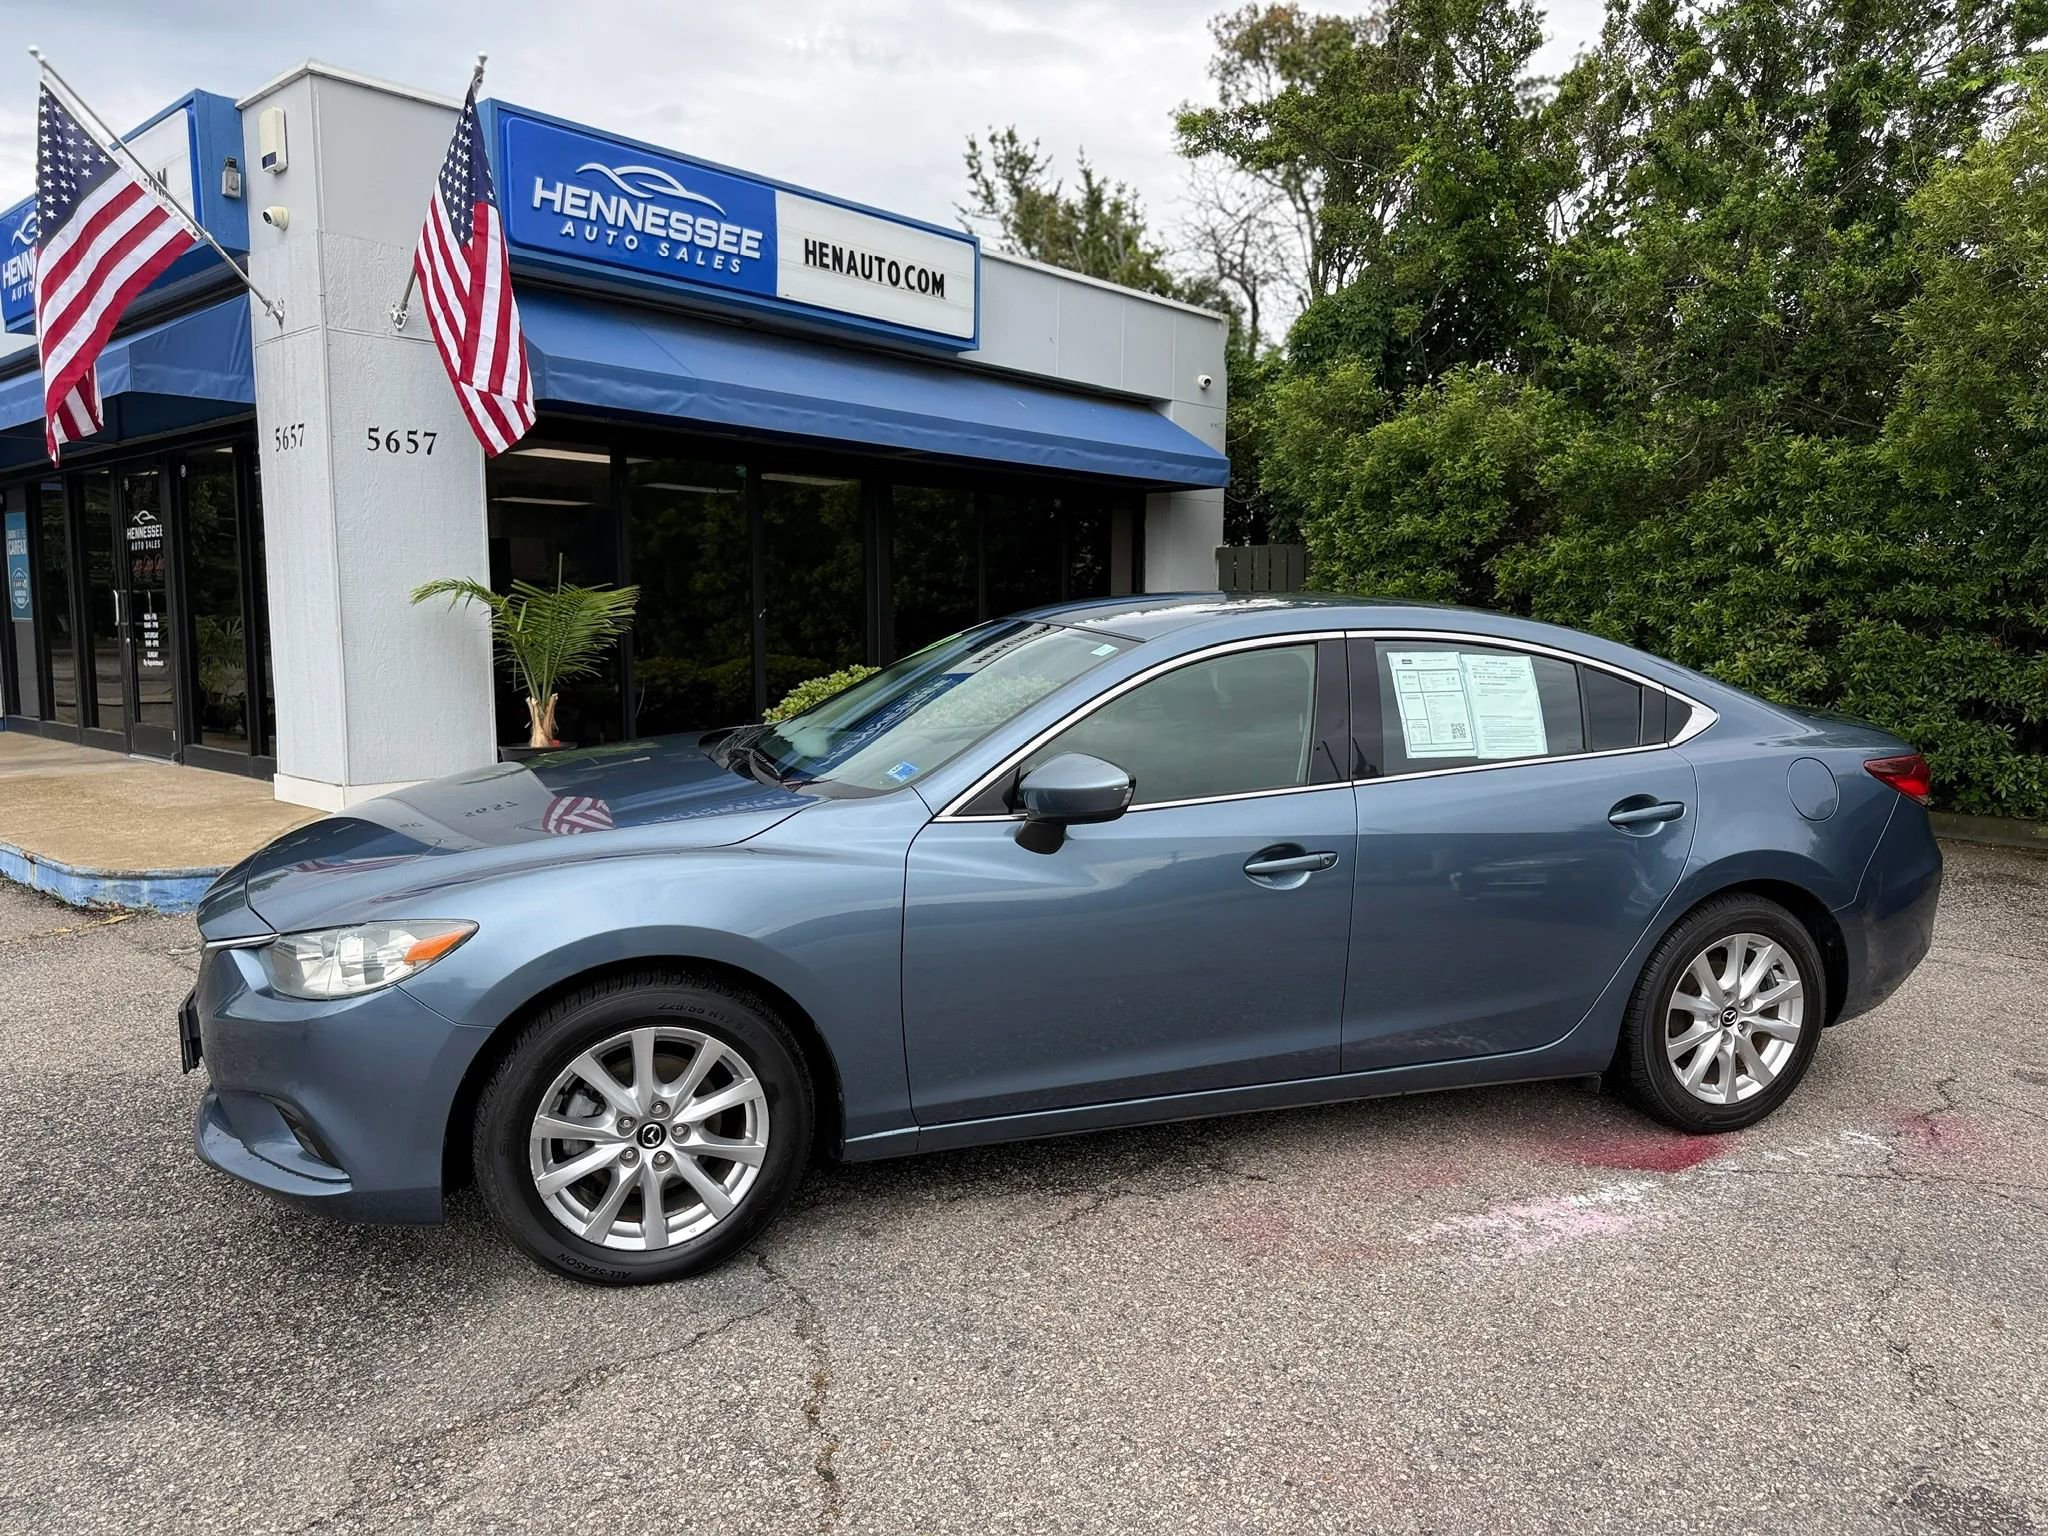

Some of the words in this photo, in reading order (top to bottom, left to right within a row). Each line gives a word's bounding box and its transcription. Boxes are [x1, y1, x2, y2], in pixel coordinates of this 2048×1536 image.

[532, 176, 763, 260] HENNESSEE
[560, 220, 639, 251] AUTO
[657, 242, 742, 274] SALES
[11, 280, 33, 303] AUTO
[274, 422, 306, 452] 5657
[366, 426, 438, 456] 5657
[126, 523, 163, 540] HENNESSEE
[145, 539, 161, 550] SALES
[557, 1252, 632, 1279] ALL-SEASON
